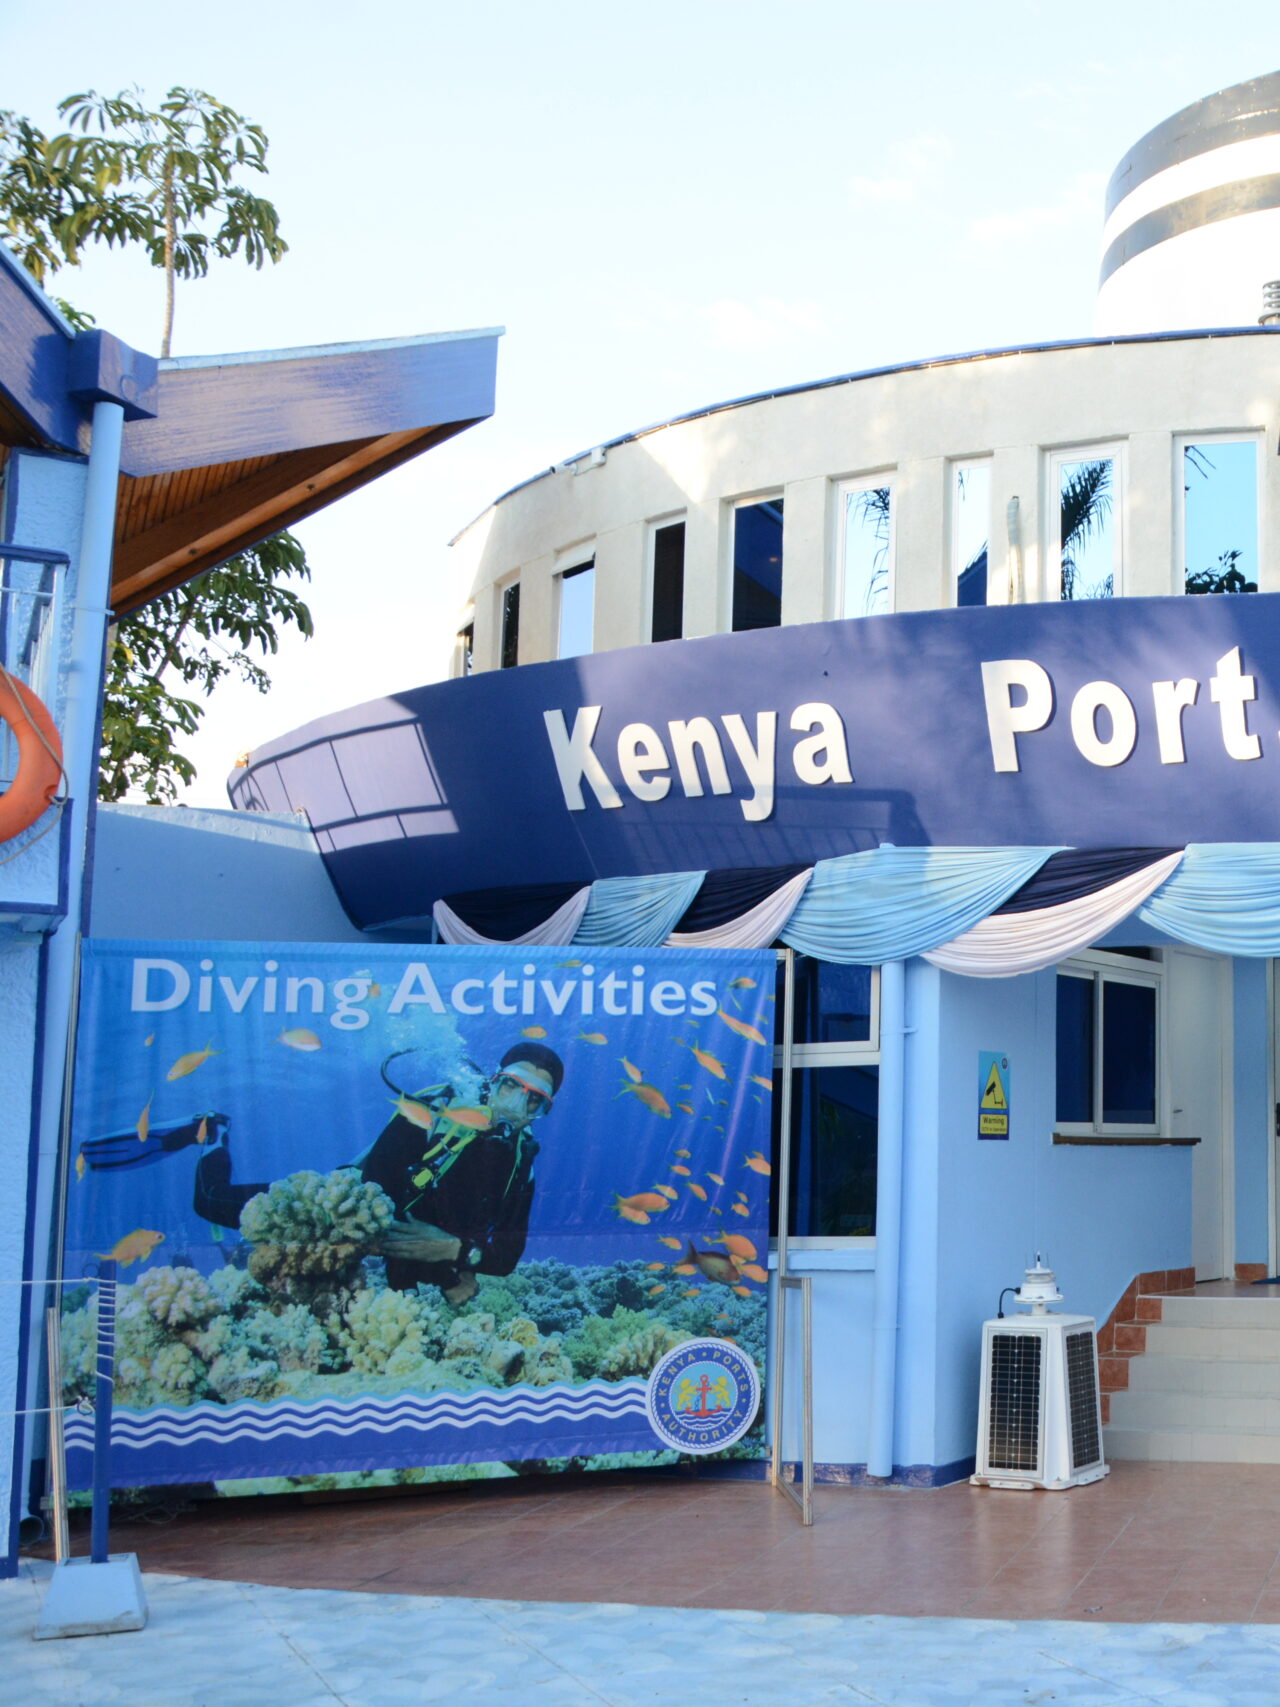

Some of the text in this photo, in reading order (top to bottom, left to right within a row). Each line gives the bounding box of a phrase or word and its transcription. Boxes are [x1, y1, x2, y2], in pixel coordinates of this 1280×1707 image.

[543, 701, 853, 822] Kenya
[131, 958, 719, 1030] Diving Activities
[658, 1351, 749, 1397] KENYA PORTS
[662, 1410, 743, 1441] AUTHORITY
